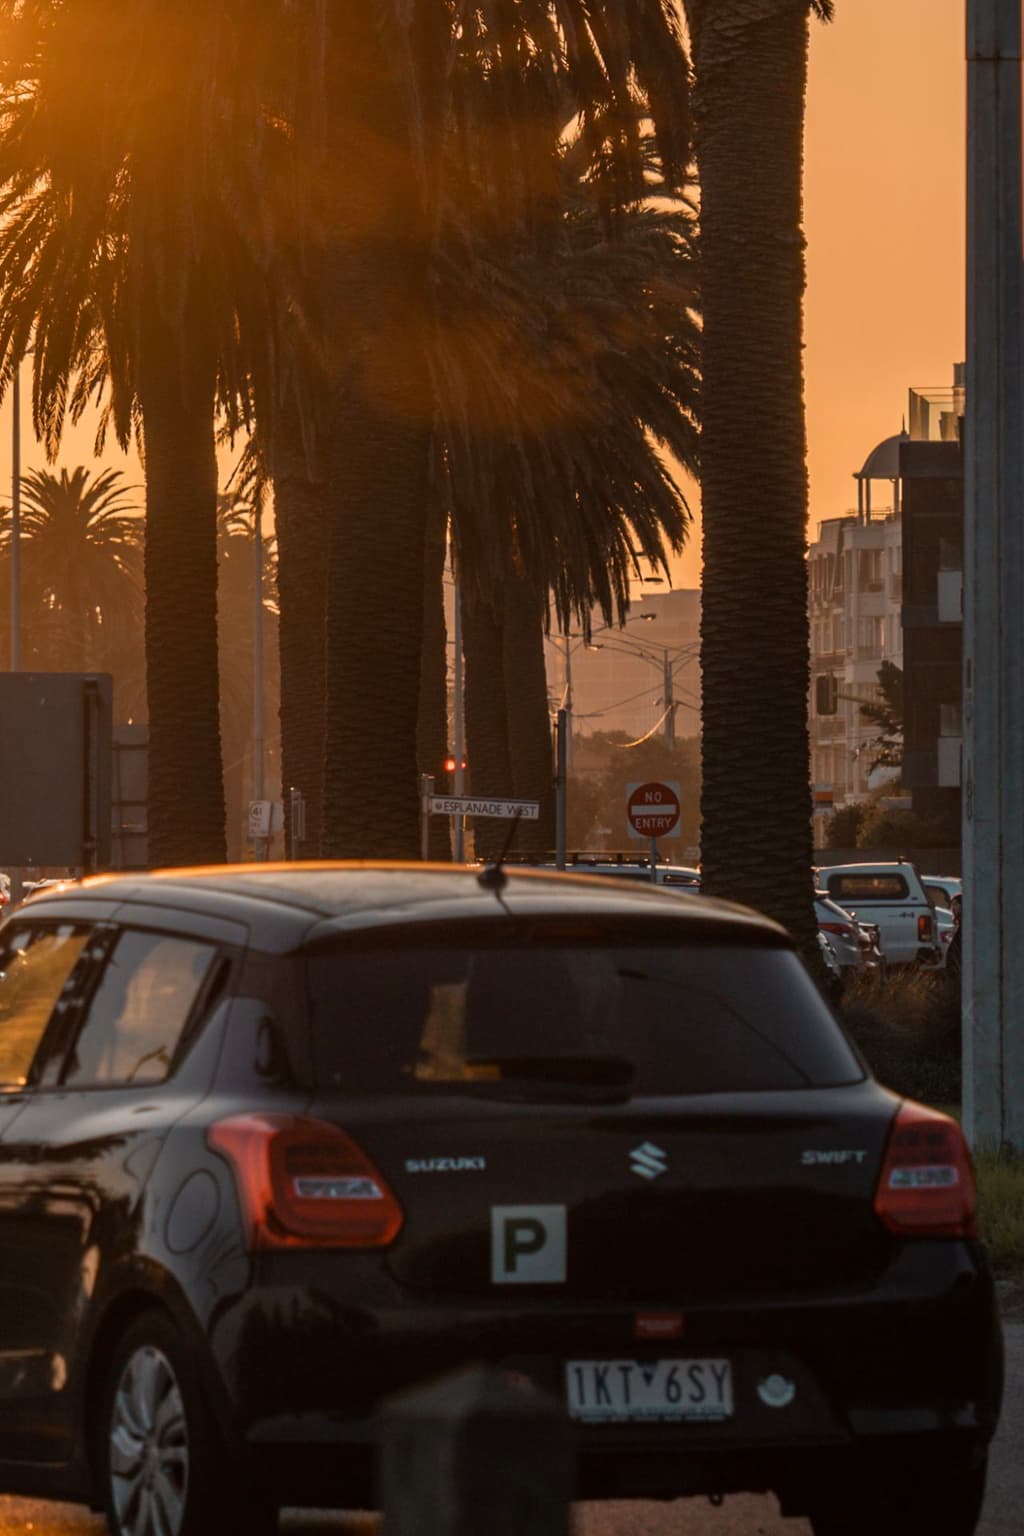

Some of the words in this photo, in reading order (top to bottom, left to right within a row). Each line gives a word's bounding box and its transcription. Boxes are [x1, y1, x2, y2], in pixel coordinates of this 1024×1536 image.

[644, 791, 662, 803] NO
[443, 801, 503, 814] ESPLANADE
[506, 805, 536, 816] WEST
[634, 817, 672, 831] ENTRY
[405, 1156, 486, 1172] SUZUKI
[801, 1149, 867, 1164] SWIFT
[503, 1218, 548, 1273] P
[665, 1362, 729, 1405] 6SY
